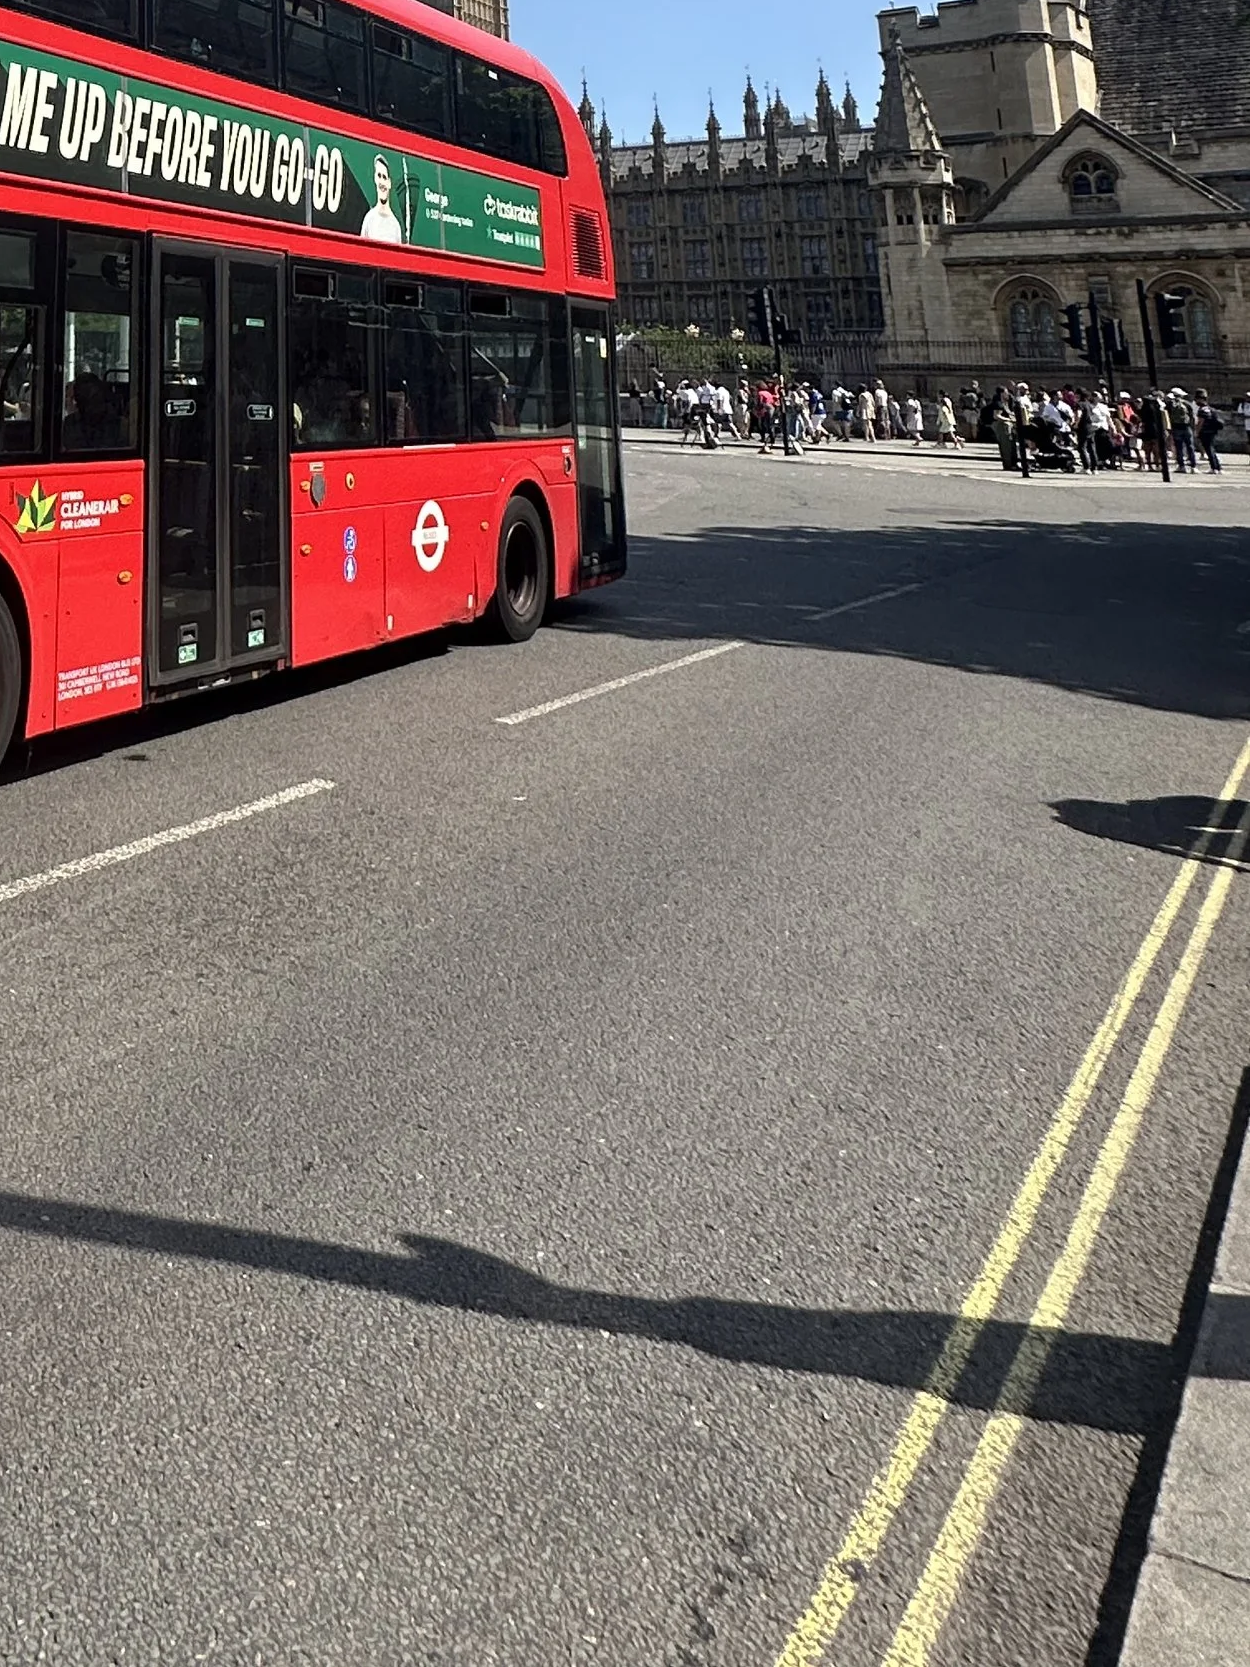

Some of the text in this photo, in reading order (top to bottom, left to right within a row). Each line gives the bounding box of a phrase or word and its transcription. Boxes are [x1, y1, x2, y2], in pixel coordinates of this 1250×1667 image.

[59, 77, 107, 162] UP
[106, 90, 218, 188] BEFORE
[219, 119, 271, 198] YOU
[271, 133, 343, 213] GO-GO
[60, 517, 101, 530] FOR LONDON
